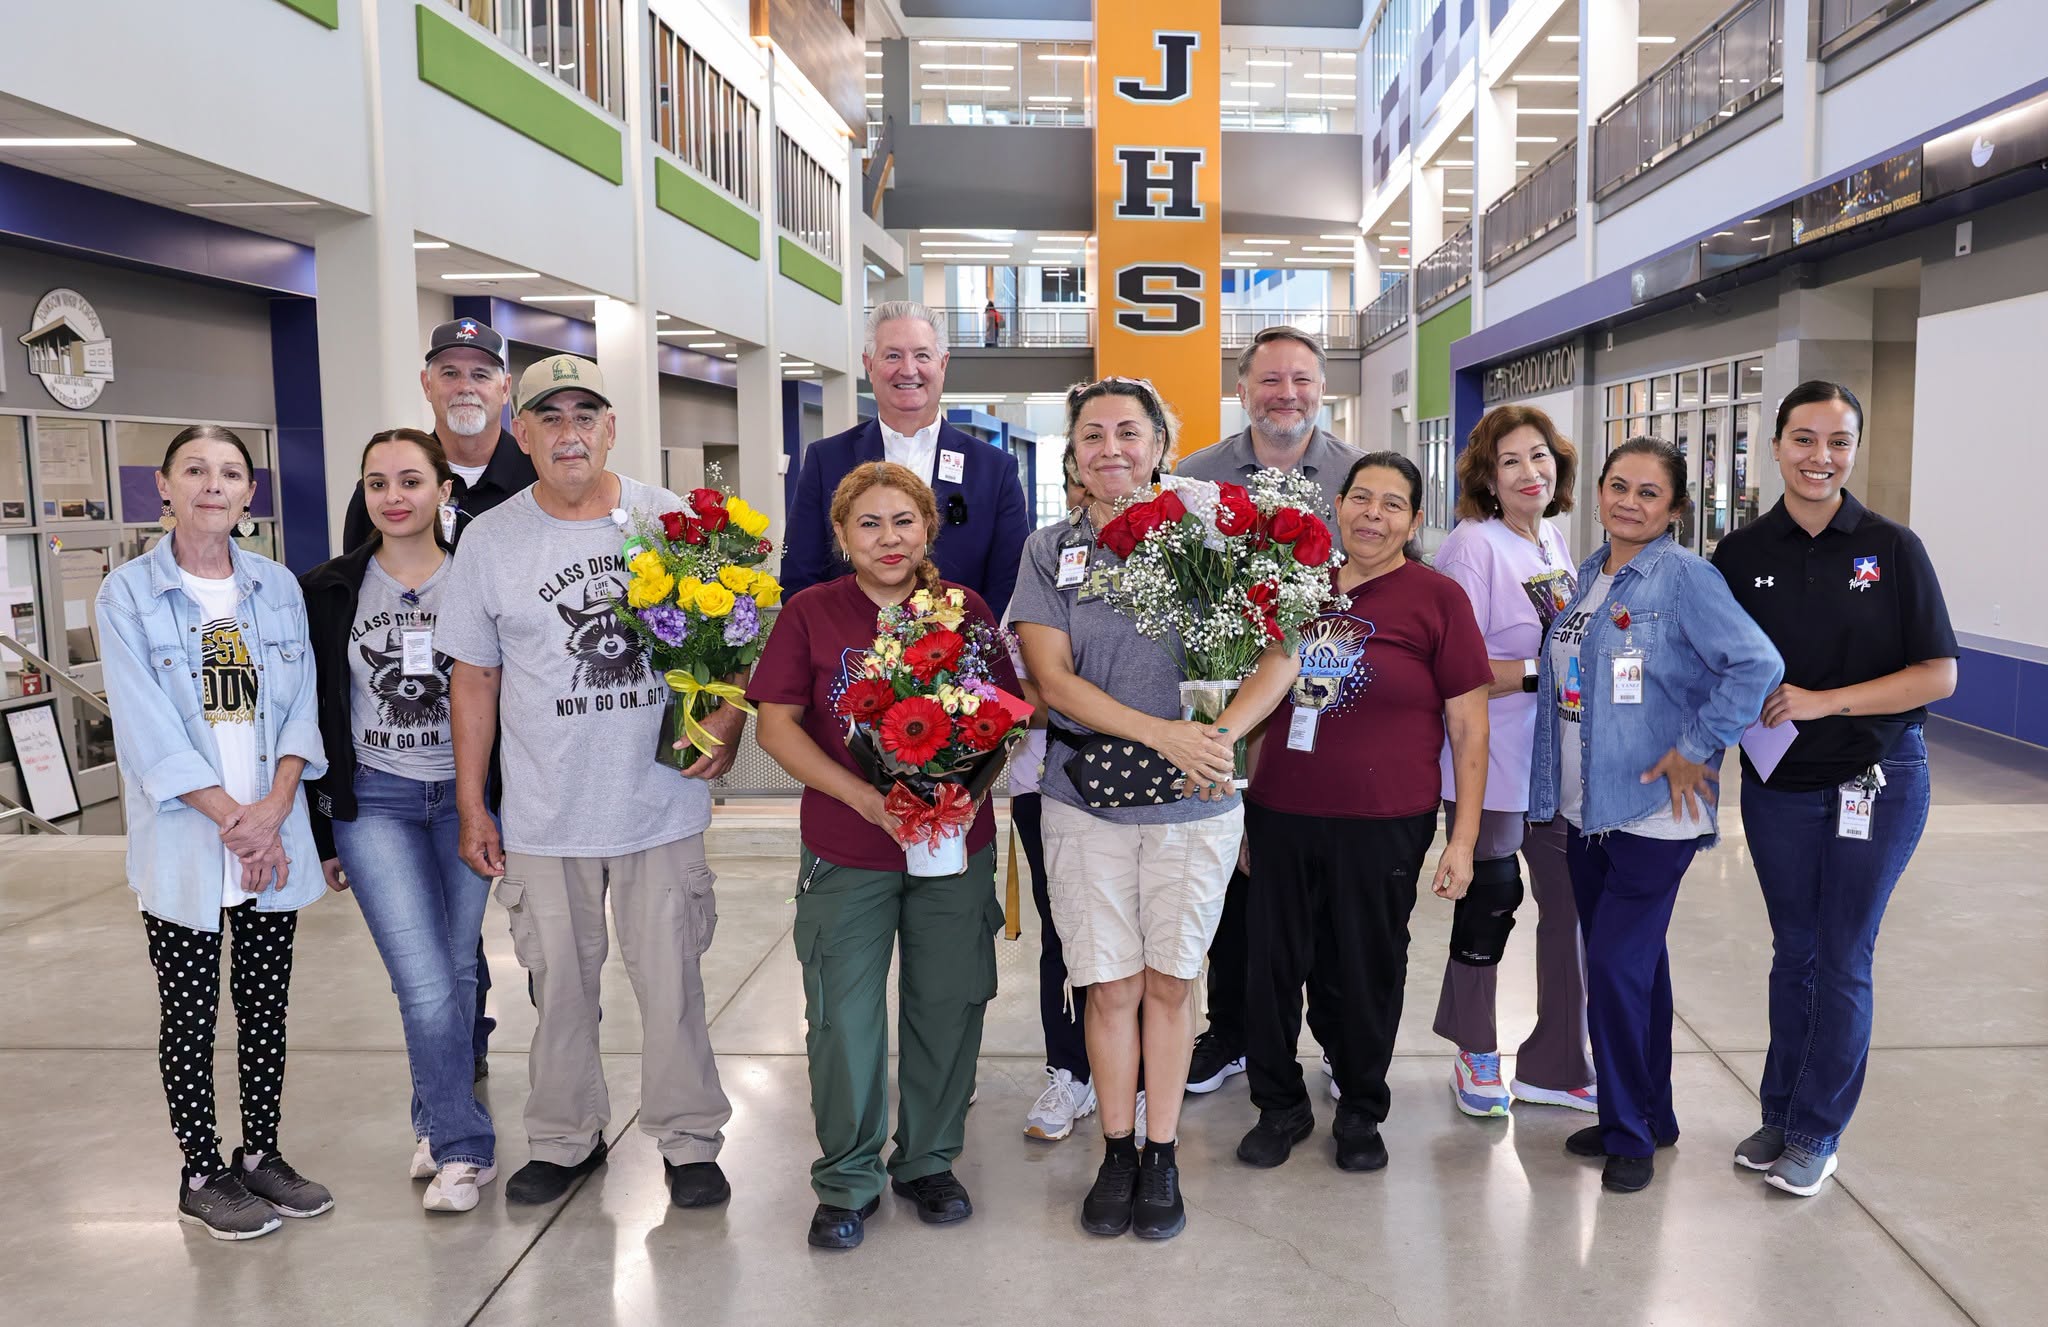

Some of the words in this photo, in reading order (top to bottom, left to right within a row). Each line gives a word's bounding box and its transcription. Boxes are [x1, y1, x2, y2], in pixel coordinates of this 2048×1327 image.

[1882, 204, 1892, 215] FOR
[1892, 190, 1921, 211] YOURSELF
[1510, 344, 1577, 398] PRODUCTION
[538, 563, 585, 603] CLASS
[594, 580, 609, 591] LOVE
[1560, 631, 1573, 643] OF
[1299, 656, 1316, 668] YS
[556, 696, 588, 717] NOW
[595, 693, 613, 712] GO
[363, 729, 391, 748] NOW
[397, 733, 415, 749] GO
